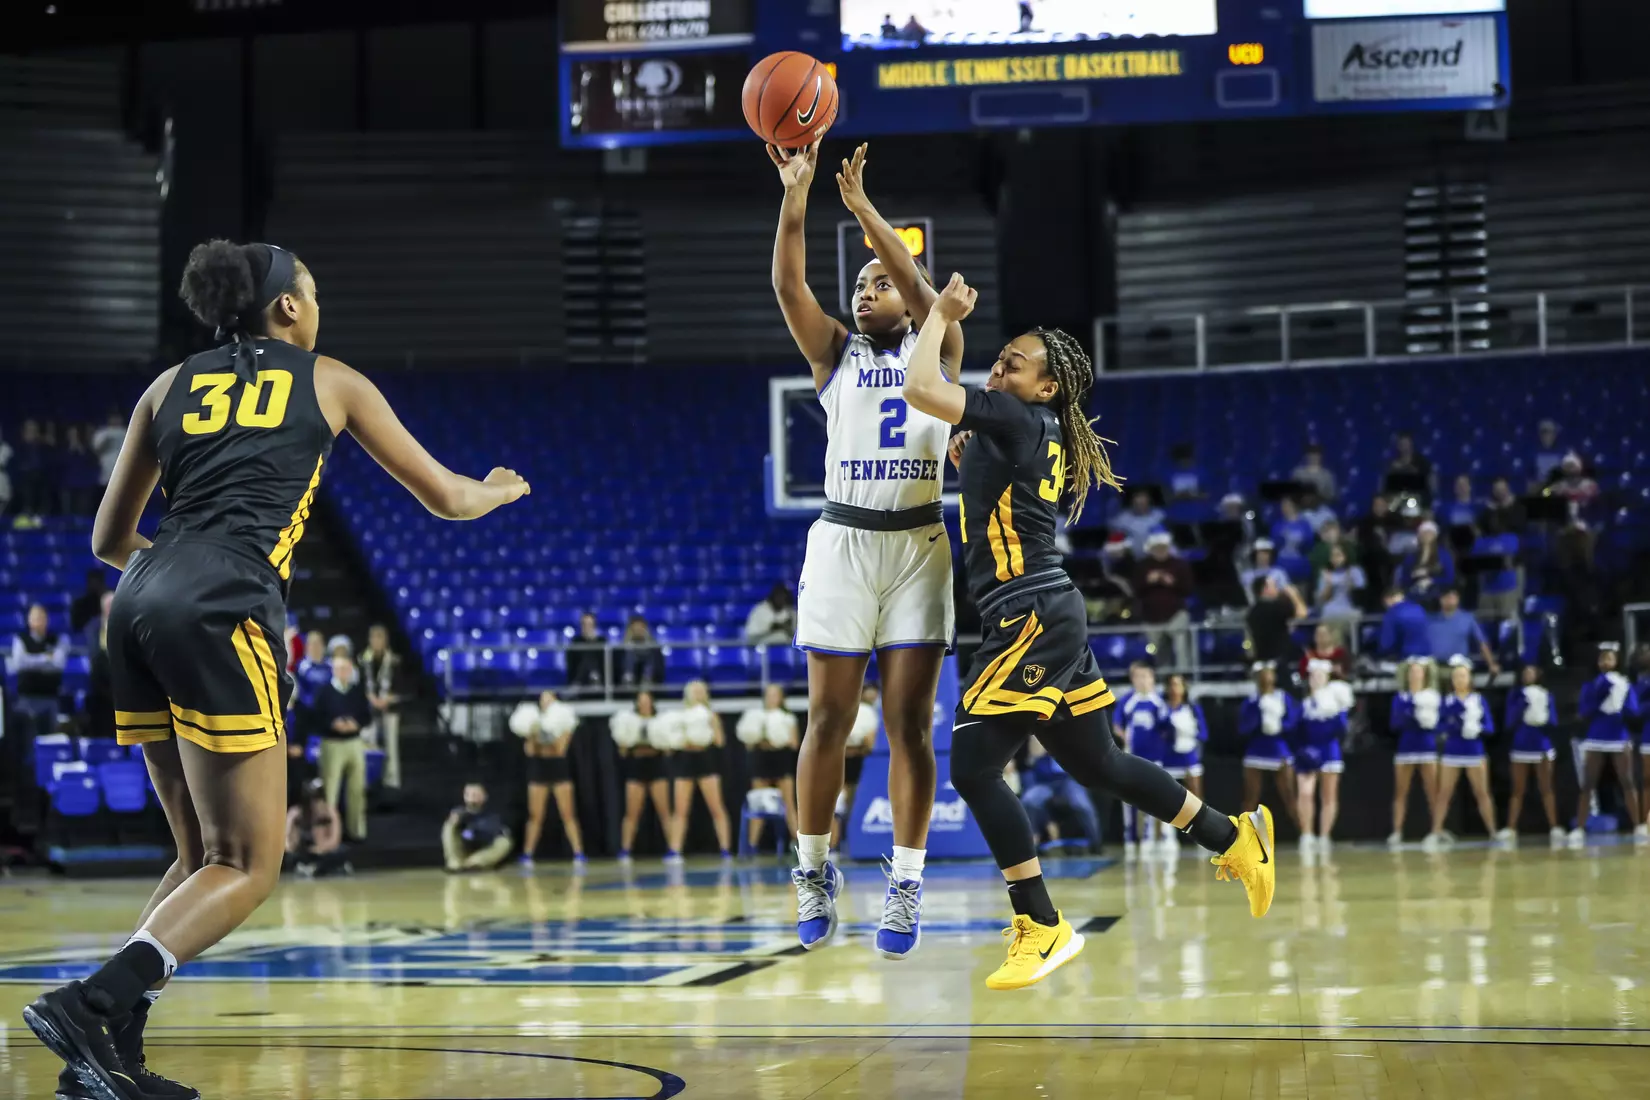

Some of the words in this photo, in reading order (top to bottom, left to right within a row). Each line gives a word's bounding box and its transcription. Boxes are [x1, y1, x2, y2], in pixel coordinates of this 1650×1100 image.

[878, 62, 947, 88] MIDDLE
[954, 55, 1059, 83] TENNESSEE
[1064, 50, 1181, 79] BASKETBALL
[1342, 40, 1463, 71] Ascend
[857, 367, 907, 388] MIDD
[182, 369, 294, 435] 30
[878, 396, 908, 450] 2
[841, 459, 939, 481] TENNESSEE
